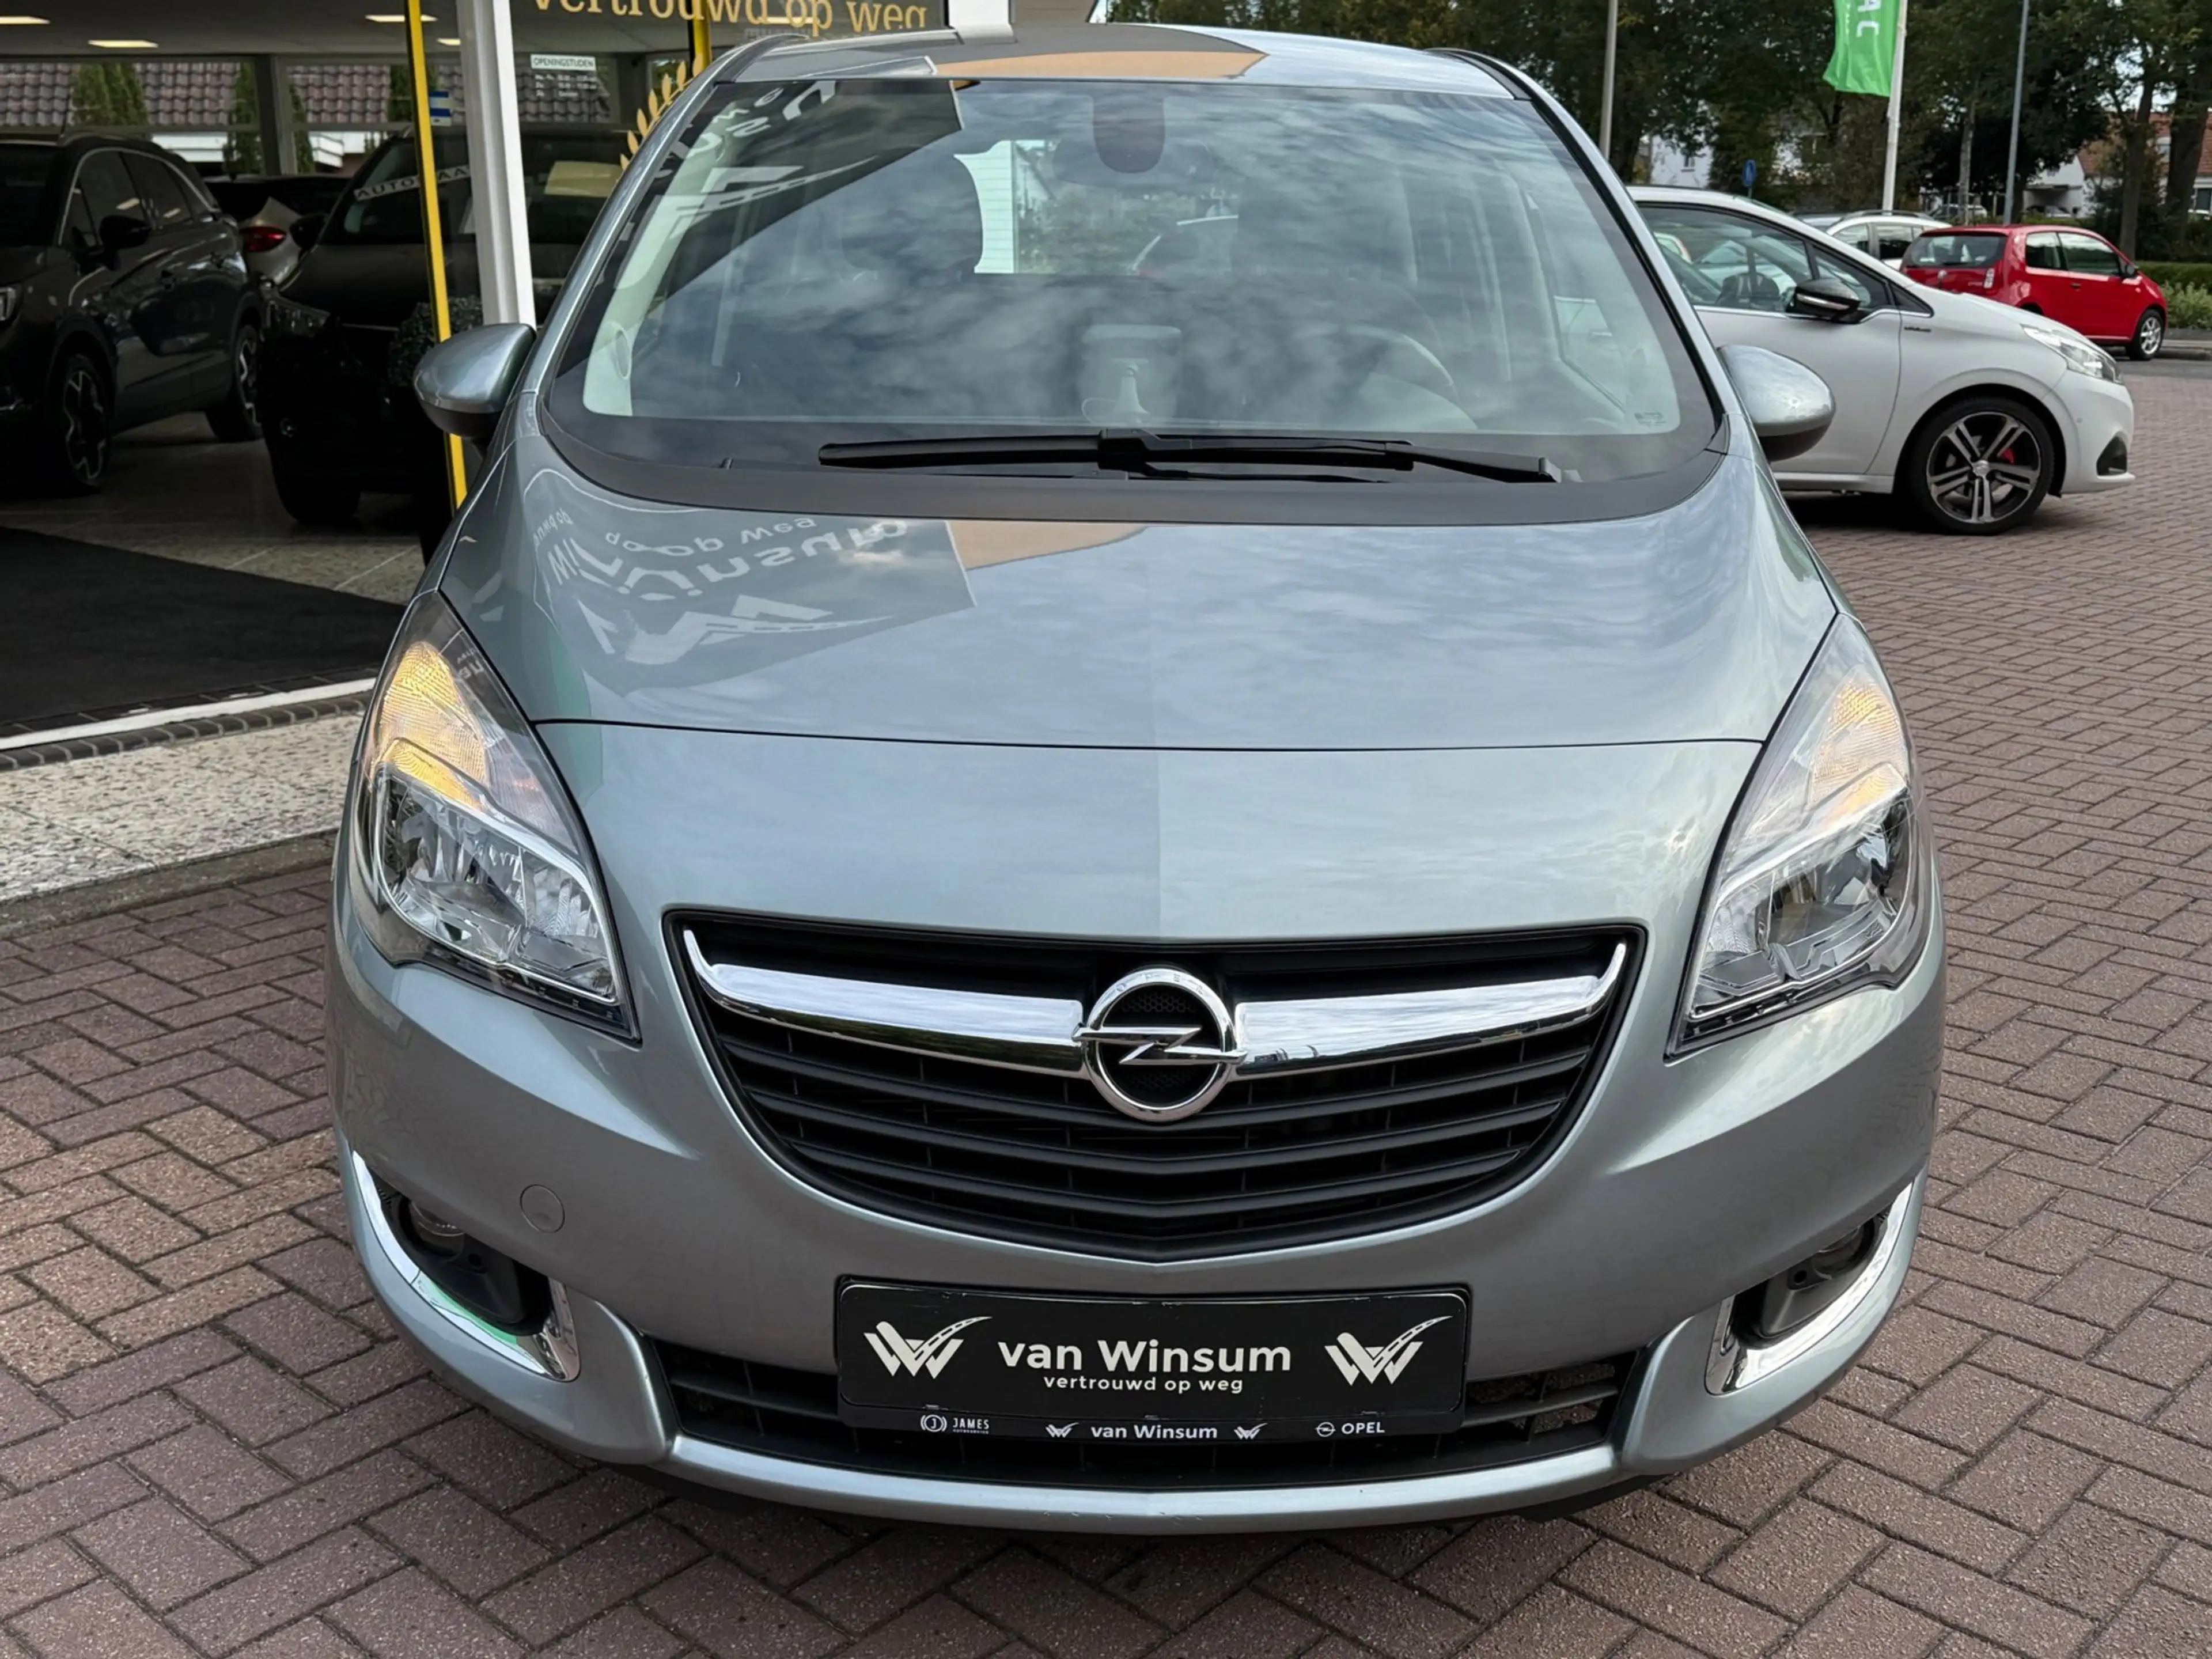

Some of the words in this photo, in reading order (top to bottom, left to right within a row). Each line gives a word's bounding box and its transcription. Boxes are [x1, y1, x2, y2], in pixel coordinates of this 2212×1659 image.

[785, 0, 832, 37] op
[998, 1342, 1082, 1370] van
[1097, 1339, 1291, 1372] Winsum
[1044, 1376, 1156, 1391] vertrouwd
[1164, 1380, 1191, 1394] op
[1199, 1380, 1243, 1394] weg
[953, 1418, 990, 1430] JAMES
[1090, 1427, 1127, 1438] van
[1134, 1425, 1218, 1439] Winsum
[1341, 1421, 1385, 1434] OPEL
